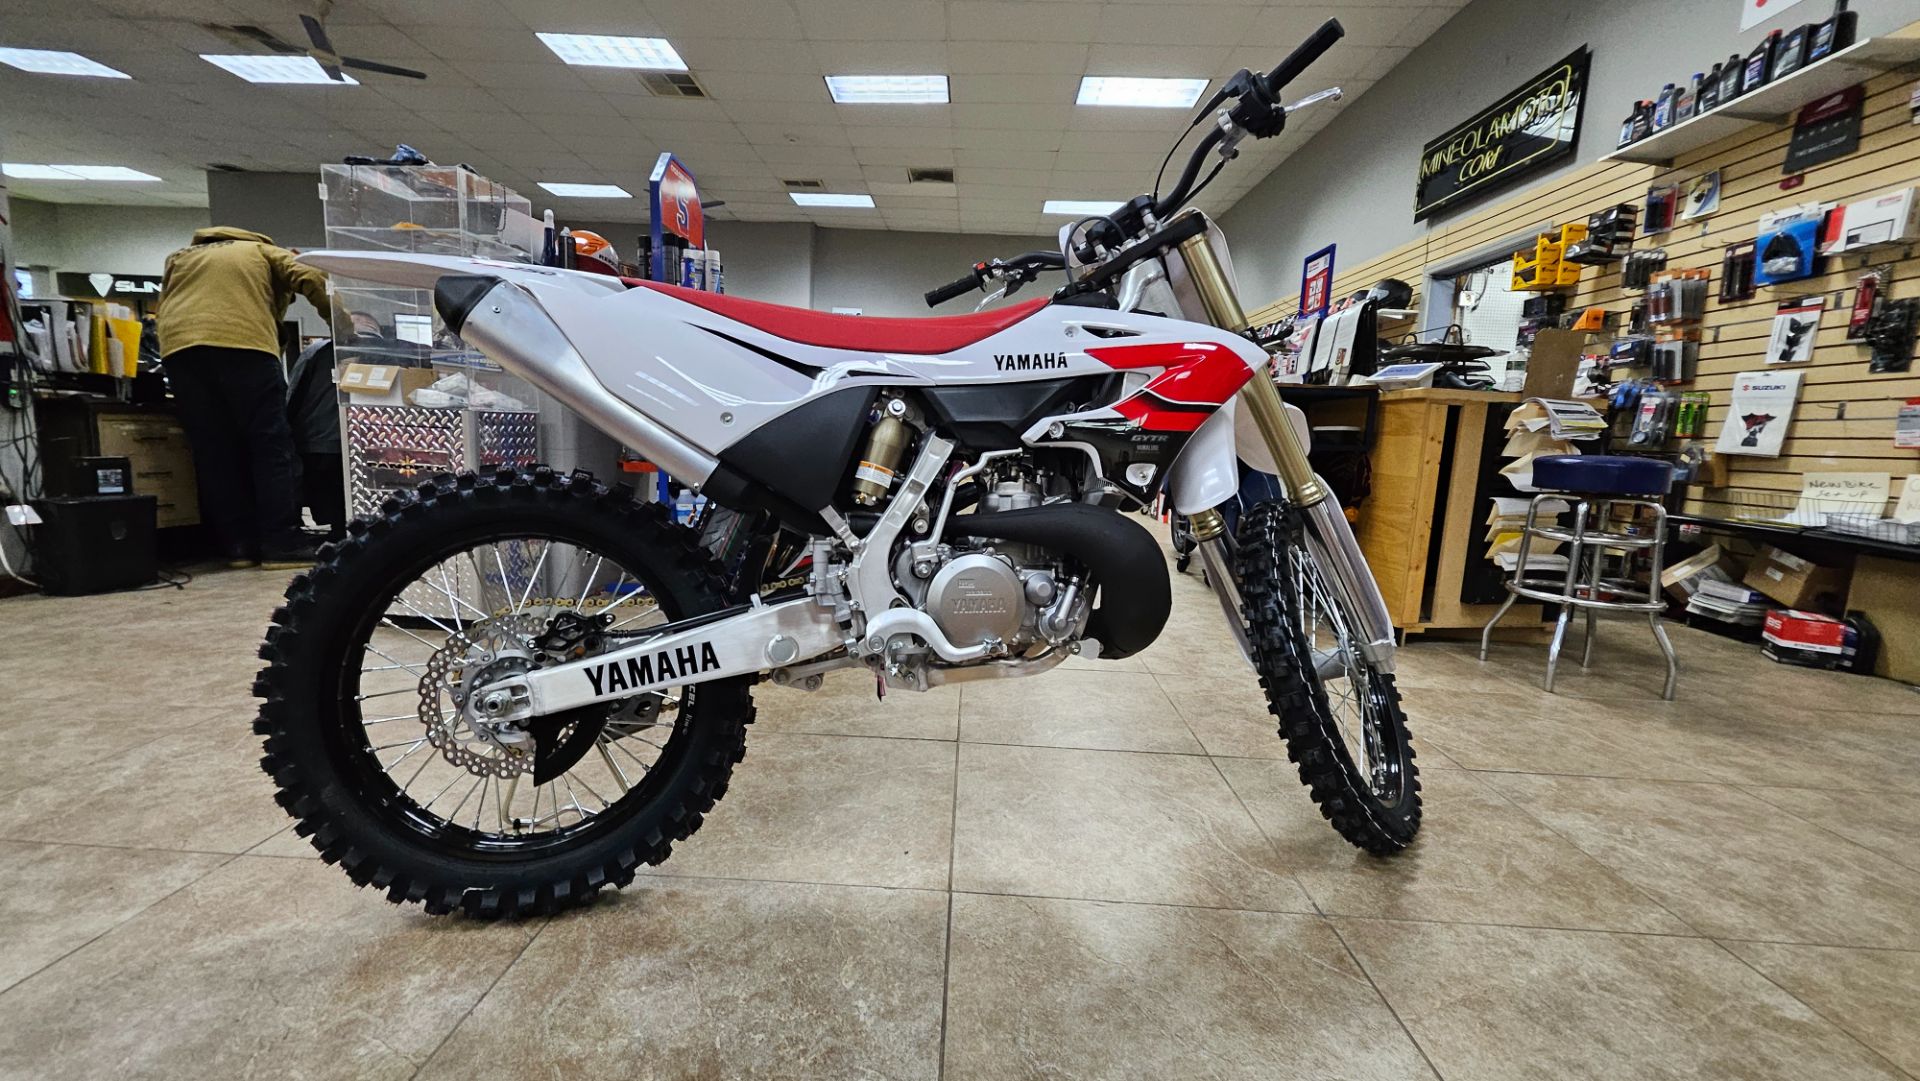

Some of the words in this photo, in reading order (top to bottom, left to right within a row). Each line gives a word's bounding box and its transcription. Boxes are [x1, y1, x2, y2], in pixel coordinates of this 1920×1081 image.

[993, 351, 1068, 371] YAMAHA
[1130, 434, 1169, 442] GYTR
[583, 641, 721, 697] YAMAHA
